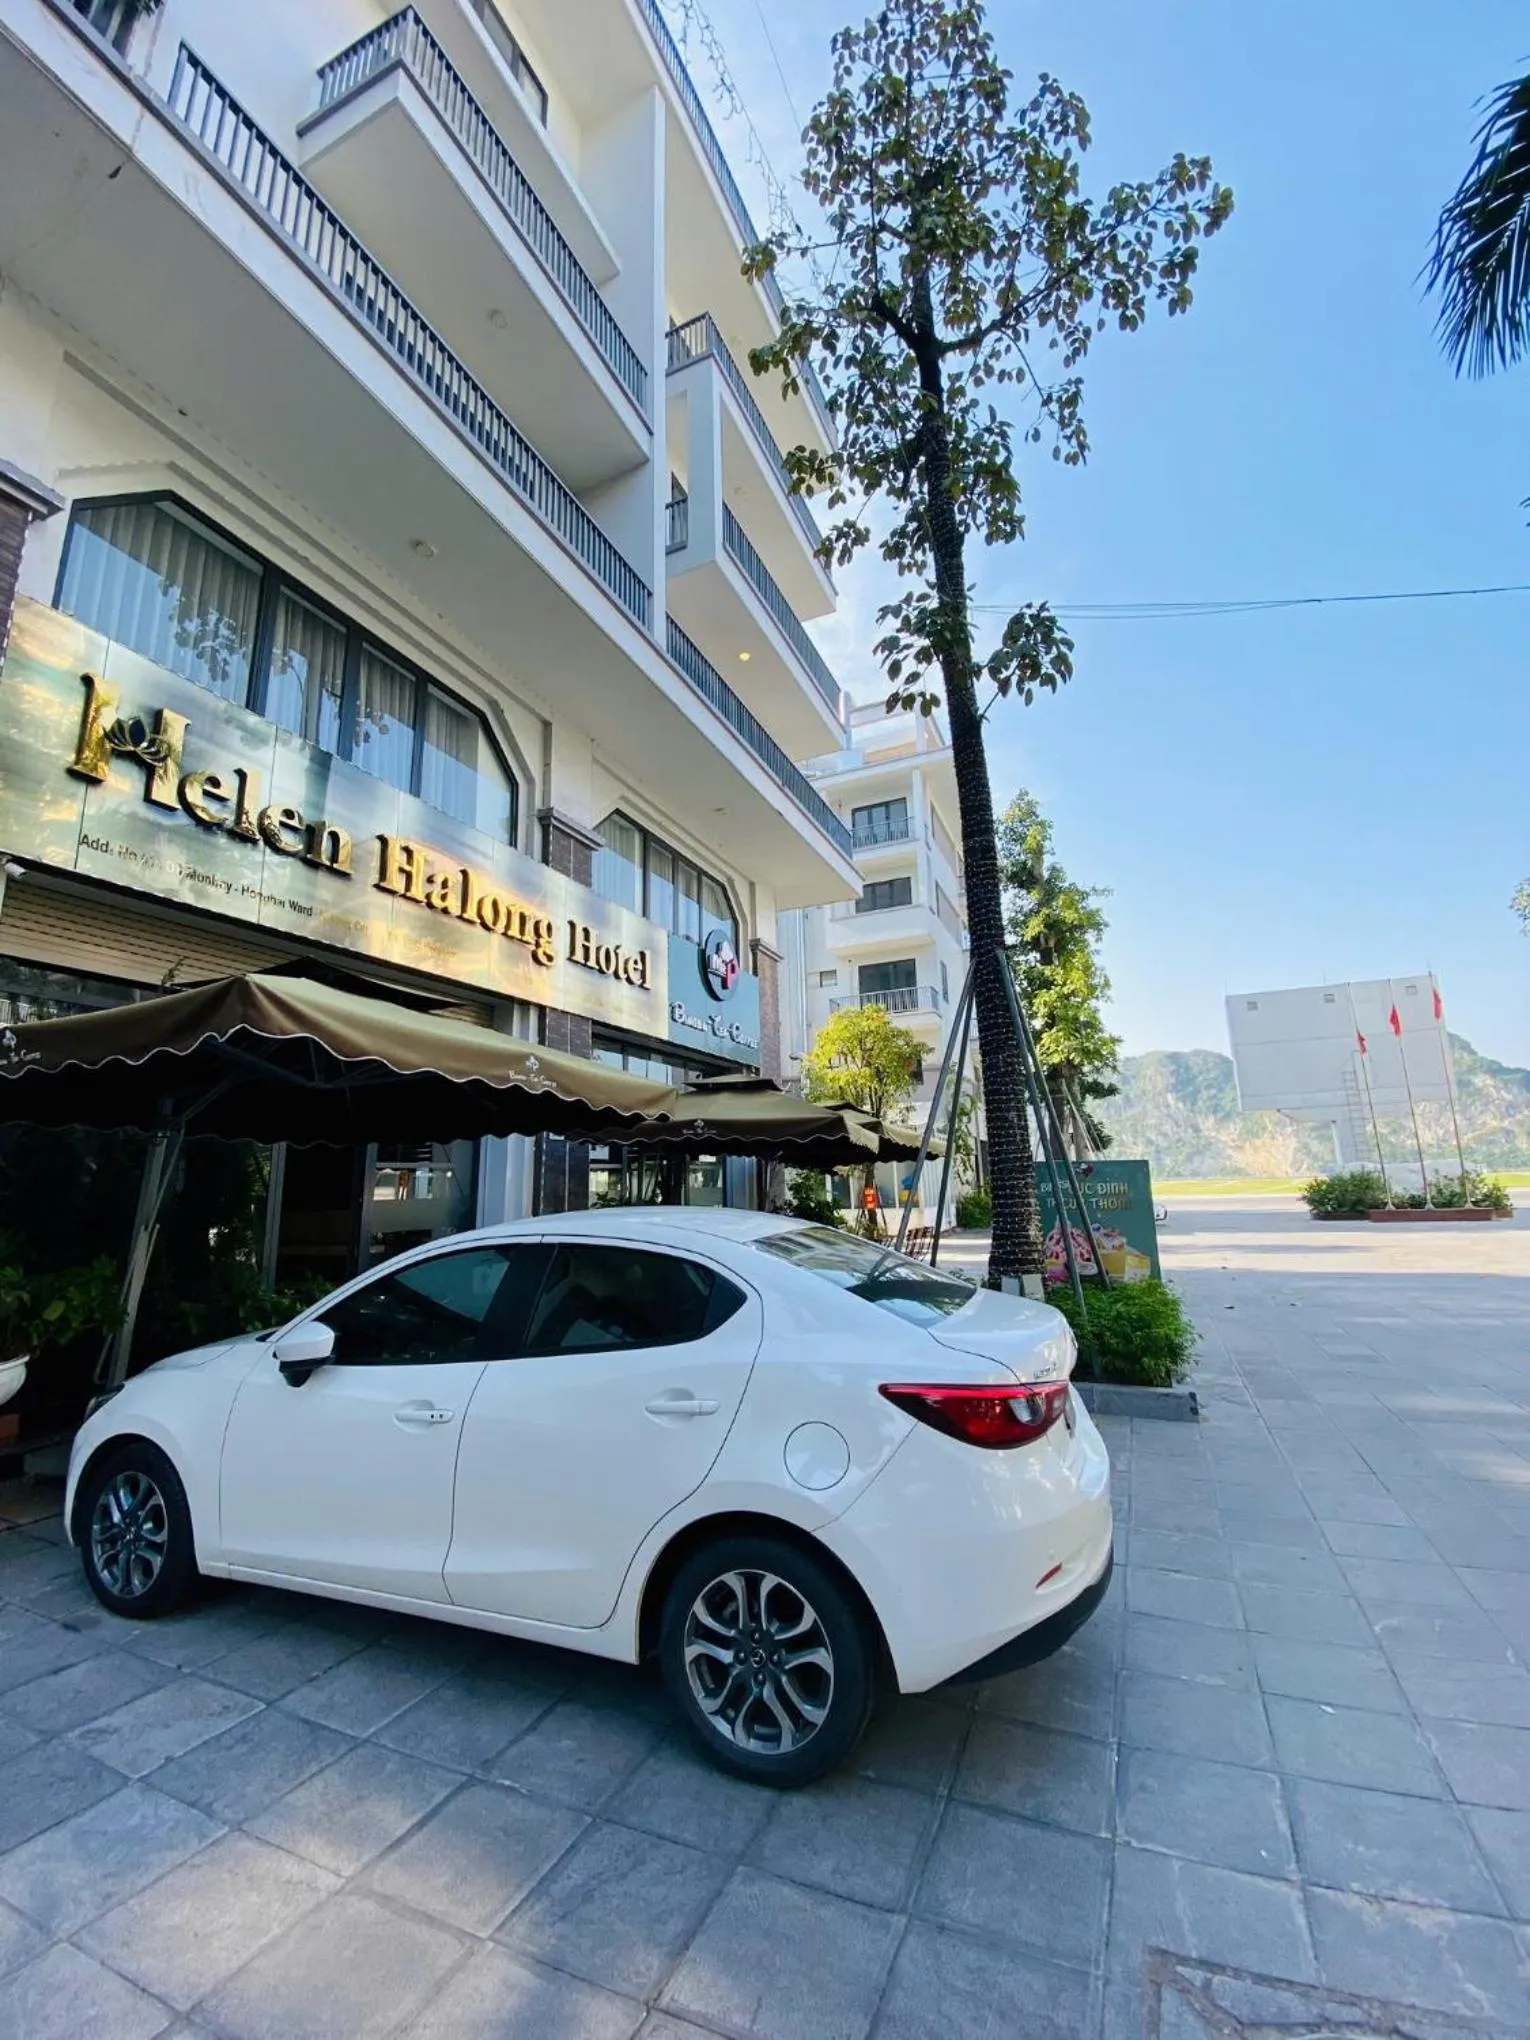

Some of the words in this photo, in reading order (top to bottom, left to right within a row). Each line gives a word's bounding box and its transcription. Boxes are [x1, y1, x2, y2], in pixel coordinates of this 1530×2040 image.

[66, 672, 354, 879] Helen
[373, 834, 554, 968] Halong
[567, 919, 651, 990] Hotel
[288, 899, 313, 917] Ward
